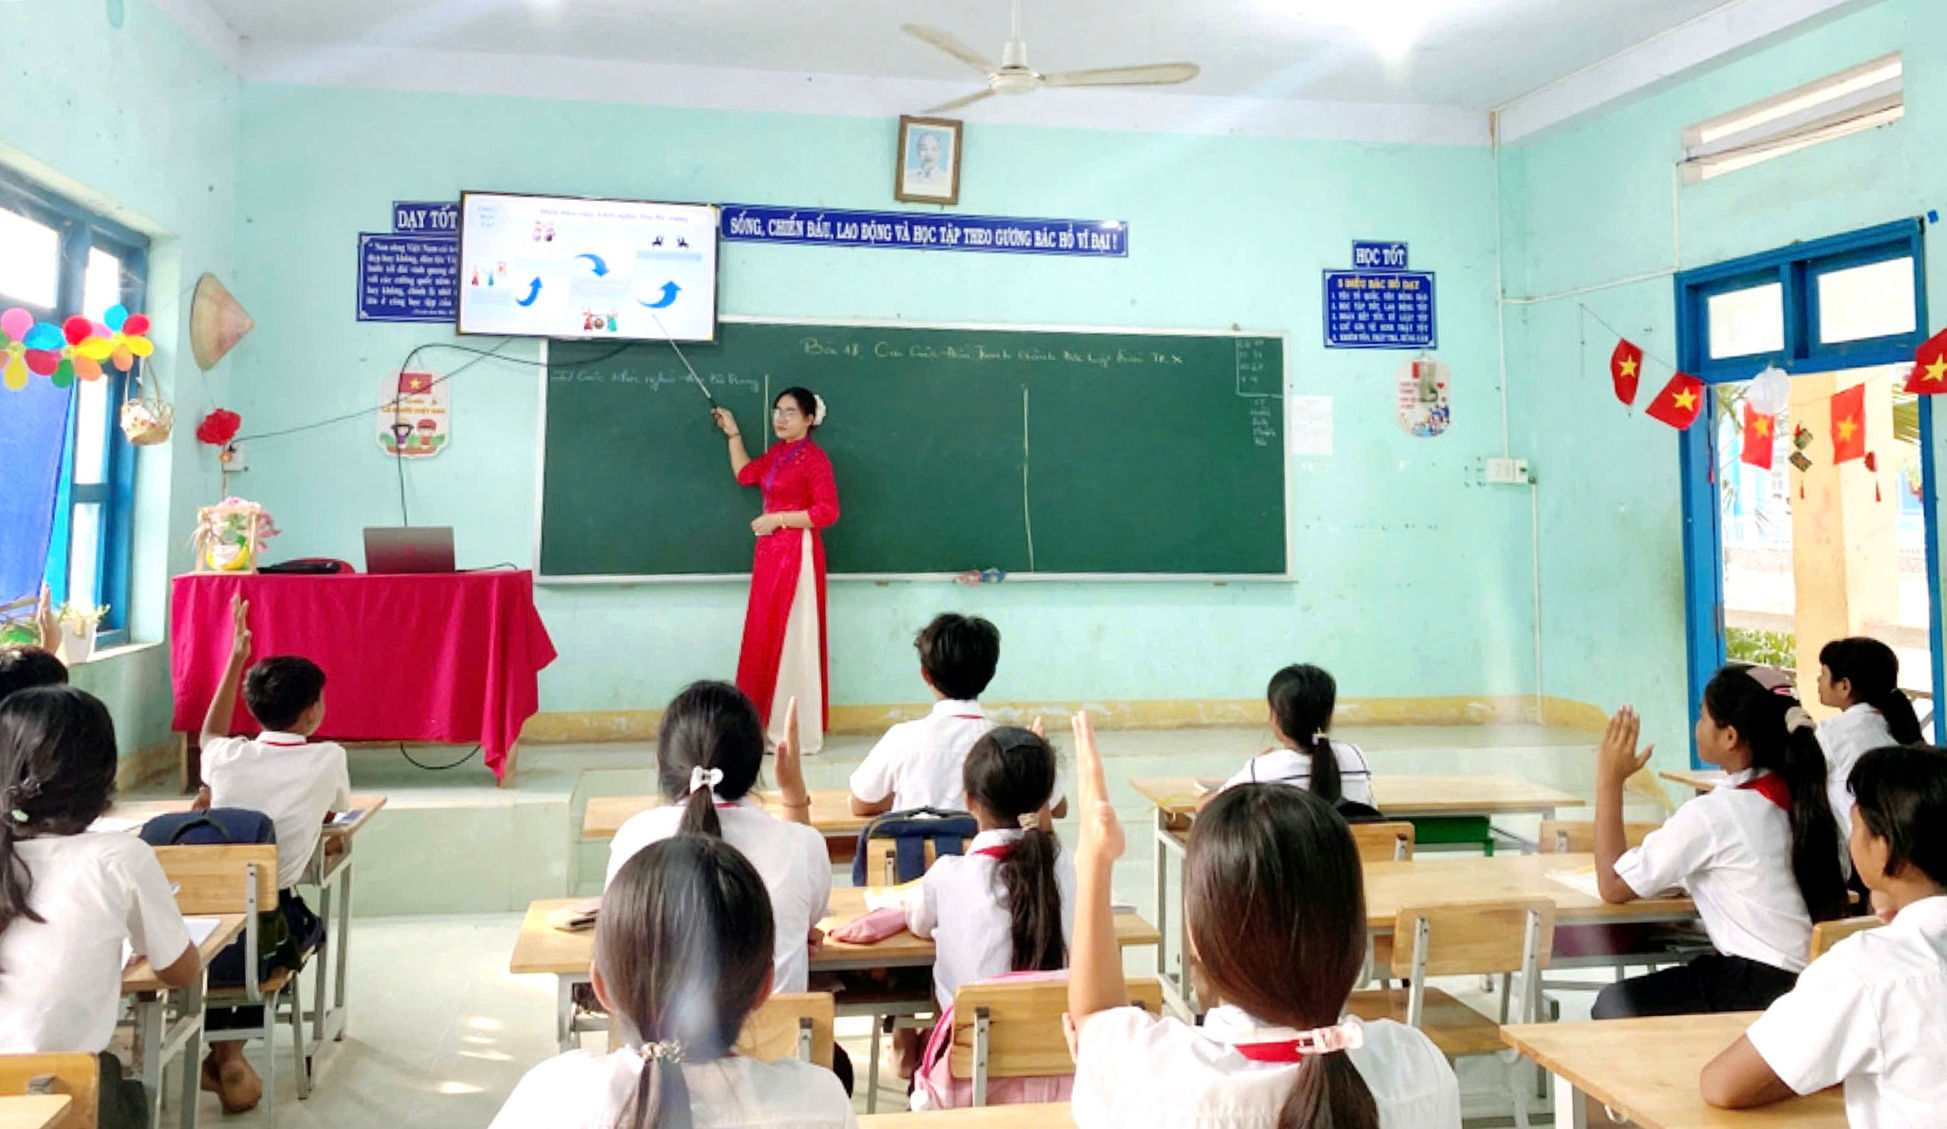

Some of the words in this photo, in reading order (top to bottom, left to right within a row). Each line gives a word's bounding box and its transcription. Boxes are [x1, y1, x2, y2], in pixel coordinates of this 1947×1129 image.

[398, 210, 426, 232] DẠY
[430, 204, 458, 229] TỐT
[730, 210, 765, 237] SỐNG,
[768, 212, 804, 238] CHIẾN
[836, 220, 859, 239] LAO
[861, 220, 892, 244] ĐỘNG
[895, 220, 910, 242] VÀ
[913, 225, 937, 248] HỌC
[939, 222, 960, 248] TẬP
[963, 227, 992, 245] THEO
[995, 226, 1033, 248] GƯƠNG
[1034, 226, 1056, 249] BÁC
[1059, 223, 1074, 251] HỒ
[1091, 231, 1111, 253] ĐẠI
[1356, 247, 1380, 267] HỌC
[1382, 244, 1404, 265] TỐT
